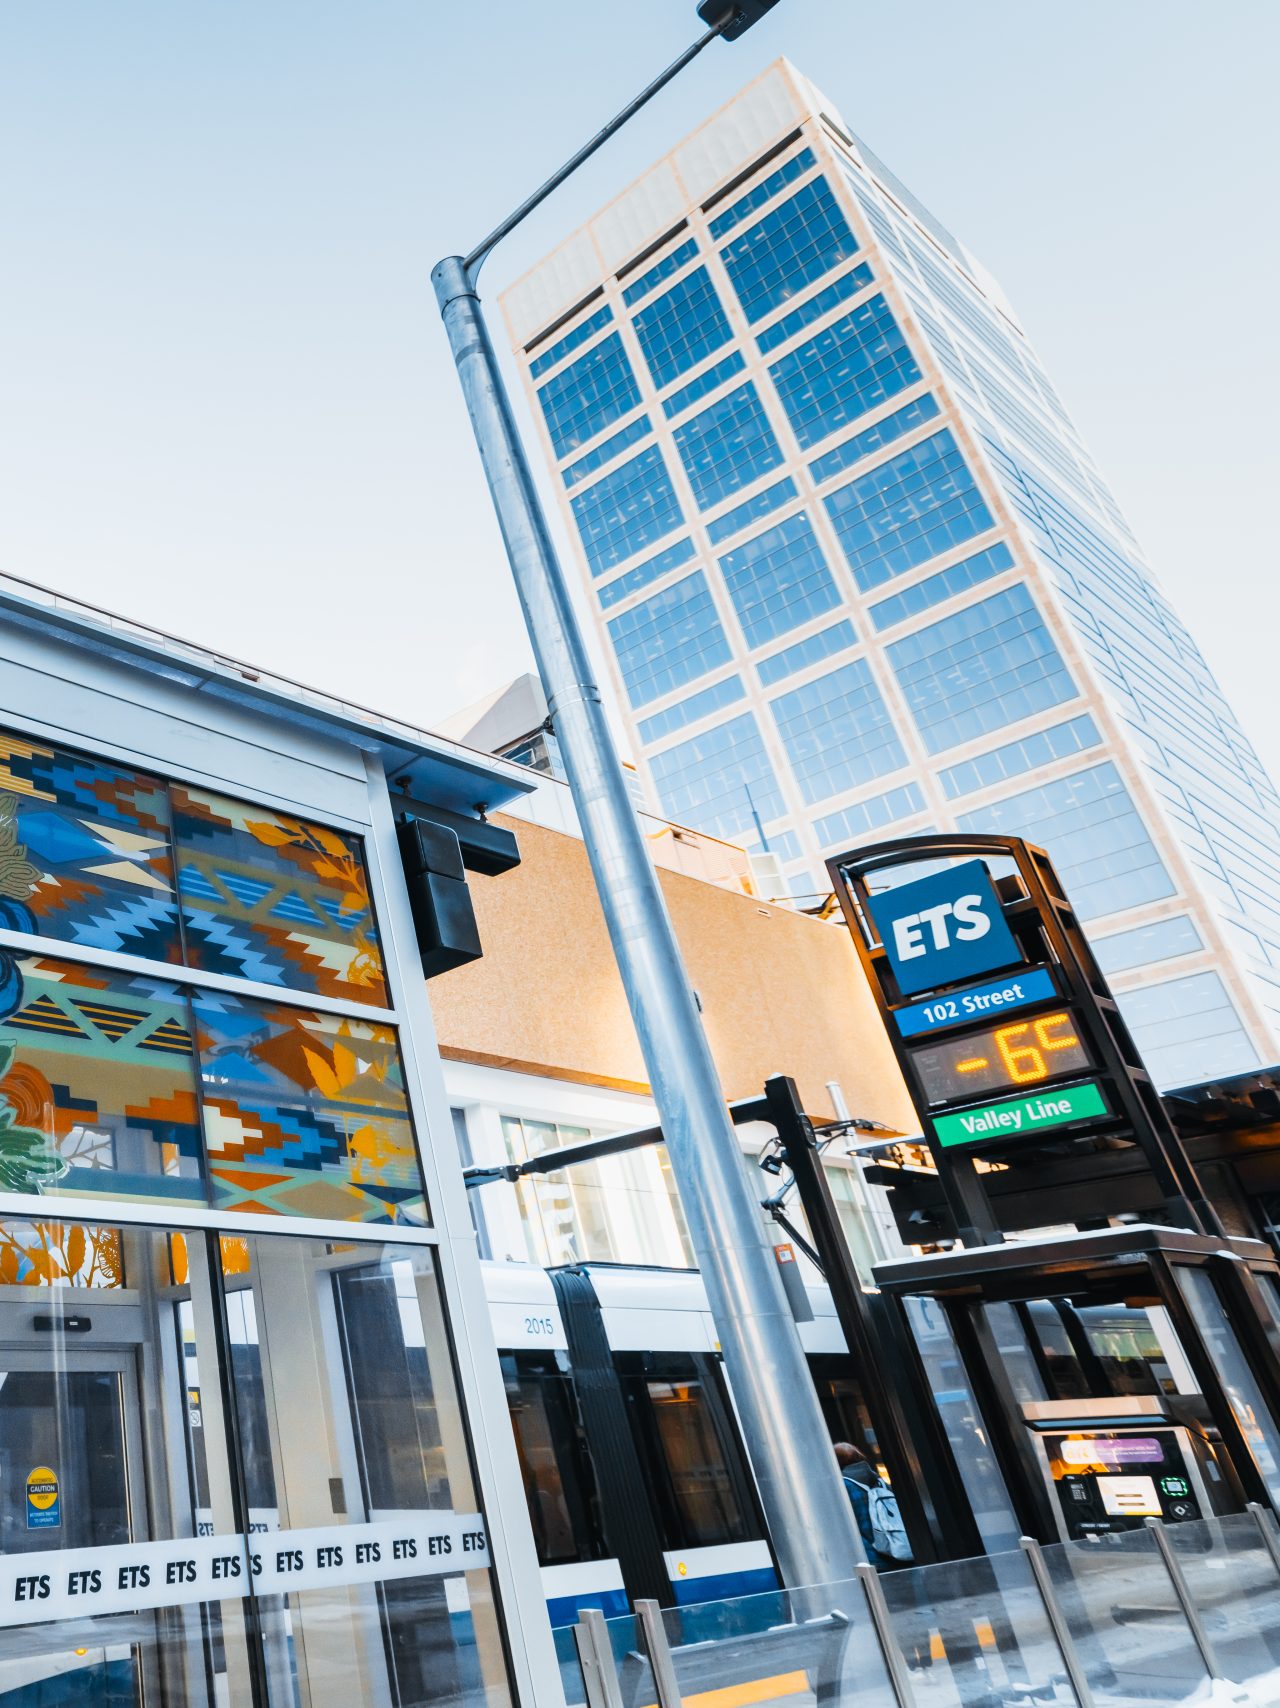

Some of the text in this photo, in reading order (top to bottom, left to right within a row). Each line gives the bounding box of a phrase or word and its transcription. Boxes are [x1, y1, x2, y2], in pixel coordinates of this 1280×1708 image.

[892, 894, 991, 962] ETS
[923, 983, 1025, 1023] 102 Street
[960, 1097, 1073, 1135] Valley Line
[524, 1317, 554, 1335] 2015
[30, 1485, 55, 1493] CAUTION
[277, 1550, 303, 1572] ETS
[317, 1546, 343, 1568] ETS
[356, 1542, 381, 1563] ETS
[393, 1538, 417, 1560] ETS
[429, 1535, 452, 1555] ETS
[462, 1531, 486, 1551] ETS
[15, 1574, 50, 1601] ETS
[68, 1569, 102, 1595] ETS
[118, 1564, 150, 1589] ETS
[166, 1559, 197, 1584] ETS
[211, 1555, 241, 1579] ETS
